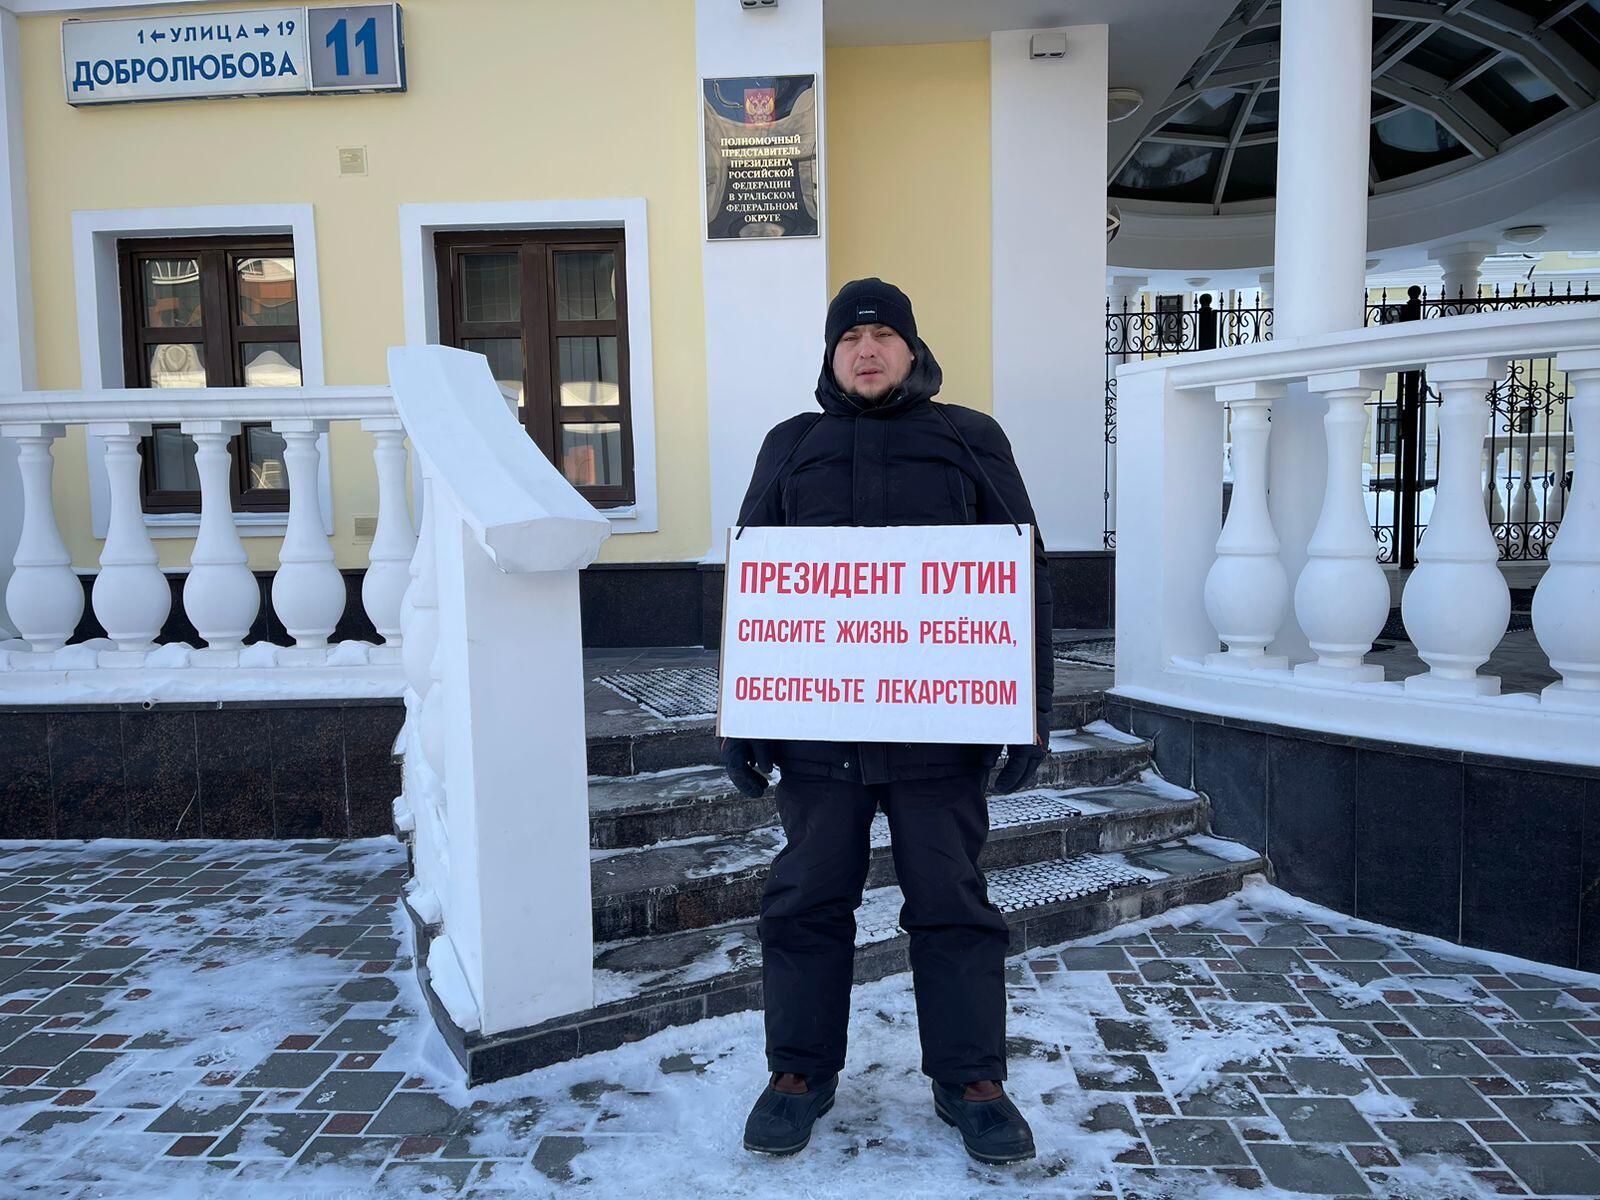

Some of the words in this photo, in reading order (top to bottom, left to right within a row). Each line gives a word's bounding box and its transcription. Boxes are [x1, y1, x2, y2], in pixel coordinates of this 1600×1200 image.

[137, 30, 144, 44] 1
[170, 23, 249, 43] УЛИЦА
[277, 21, 296, 36] 19
[325, 17, 379, 76] 11
[72, 51, 298, 92] ДОБРОЛЮБОВА
[720, 134, 801, 146] ПОЛНОМОЧНЫЙ
[721, 146, 801, 157] ПРЕДСТАВИТЕЛЬ
[730, 158, 793, 168] ПРЕЗИДЕНТА
[728, 168, 795, 179] РОССИЙСКОЙ
[732, 180, 791, 190] ФЕДЕРАЦИИ
[728, 193, 735, 201] В
[737, 191, 795, 201] УРАЛЬСКОМ
[726, 202, 798, 212] ФЕДЕРАЛЬНОМ
[744, 213, 781, 223] ОКРУГЕ
[740, 561, 906, 599] ПРЕЗИДЕНТ
[921, 561, 1017, 595] ПУТИН
[738, 619, 826, 643] СПАСИТЕ
[836, 620, 909, 644] ЖИЗНЬ
[919, 617, 1018, 648] РЕБЁНКА,
[735, 677, 865, 704] ОБЕСПЕЧЬТЕ
[876, 679, 1018, 706] ЛЕКАРСТВОМ
